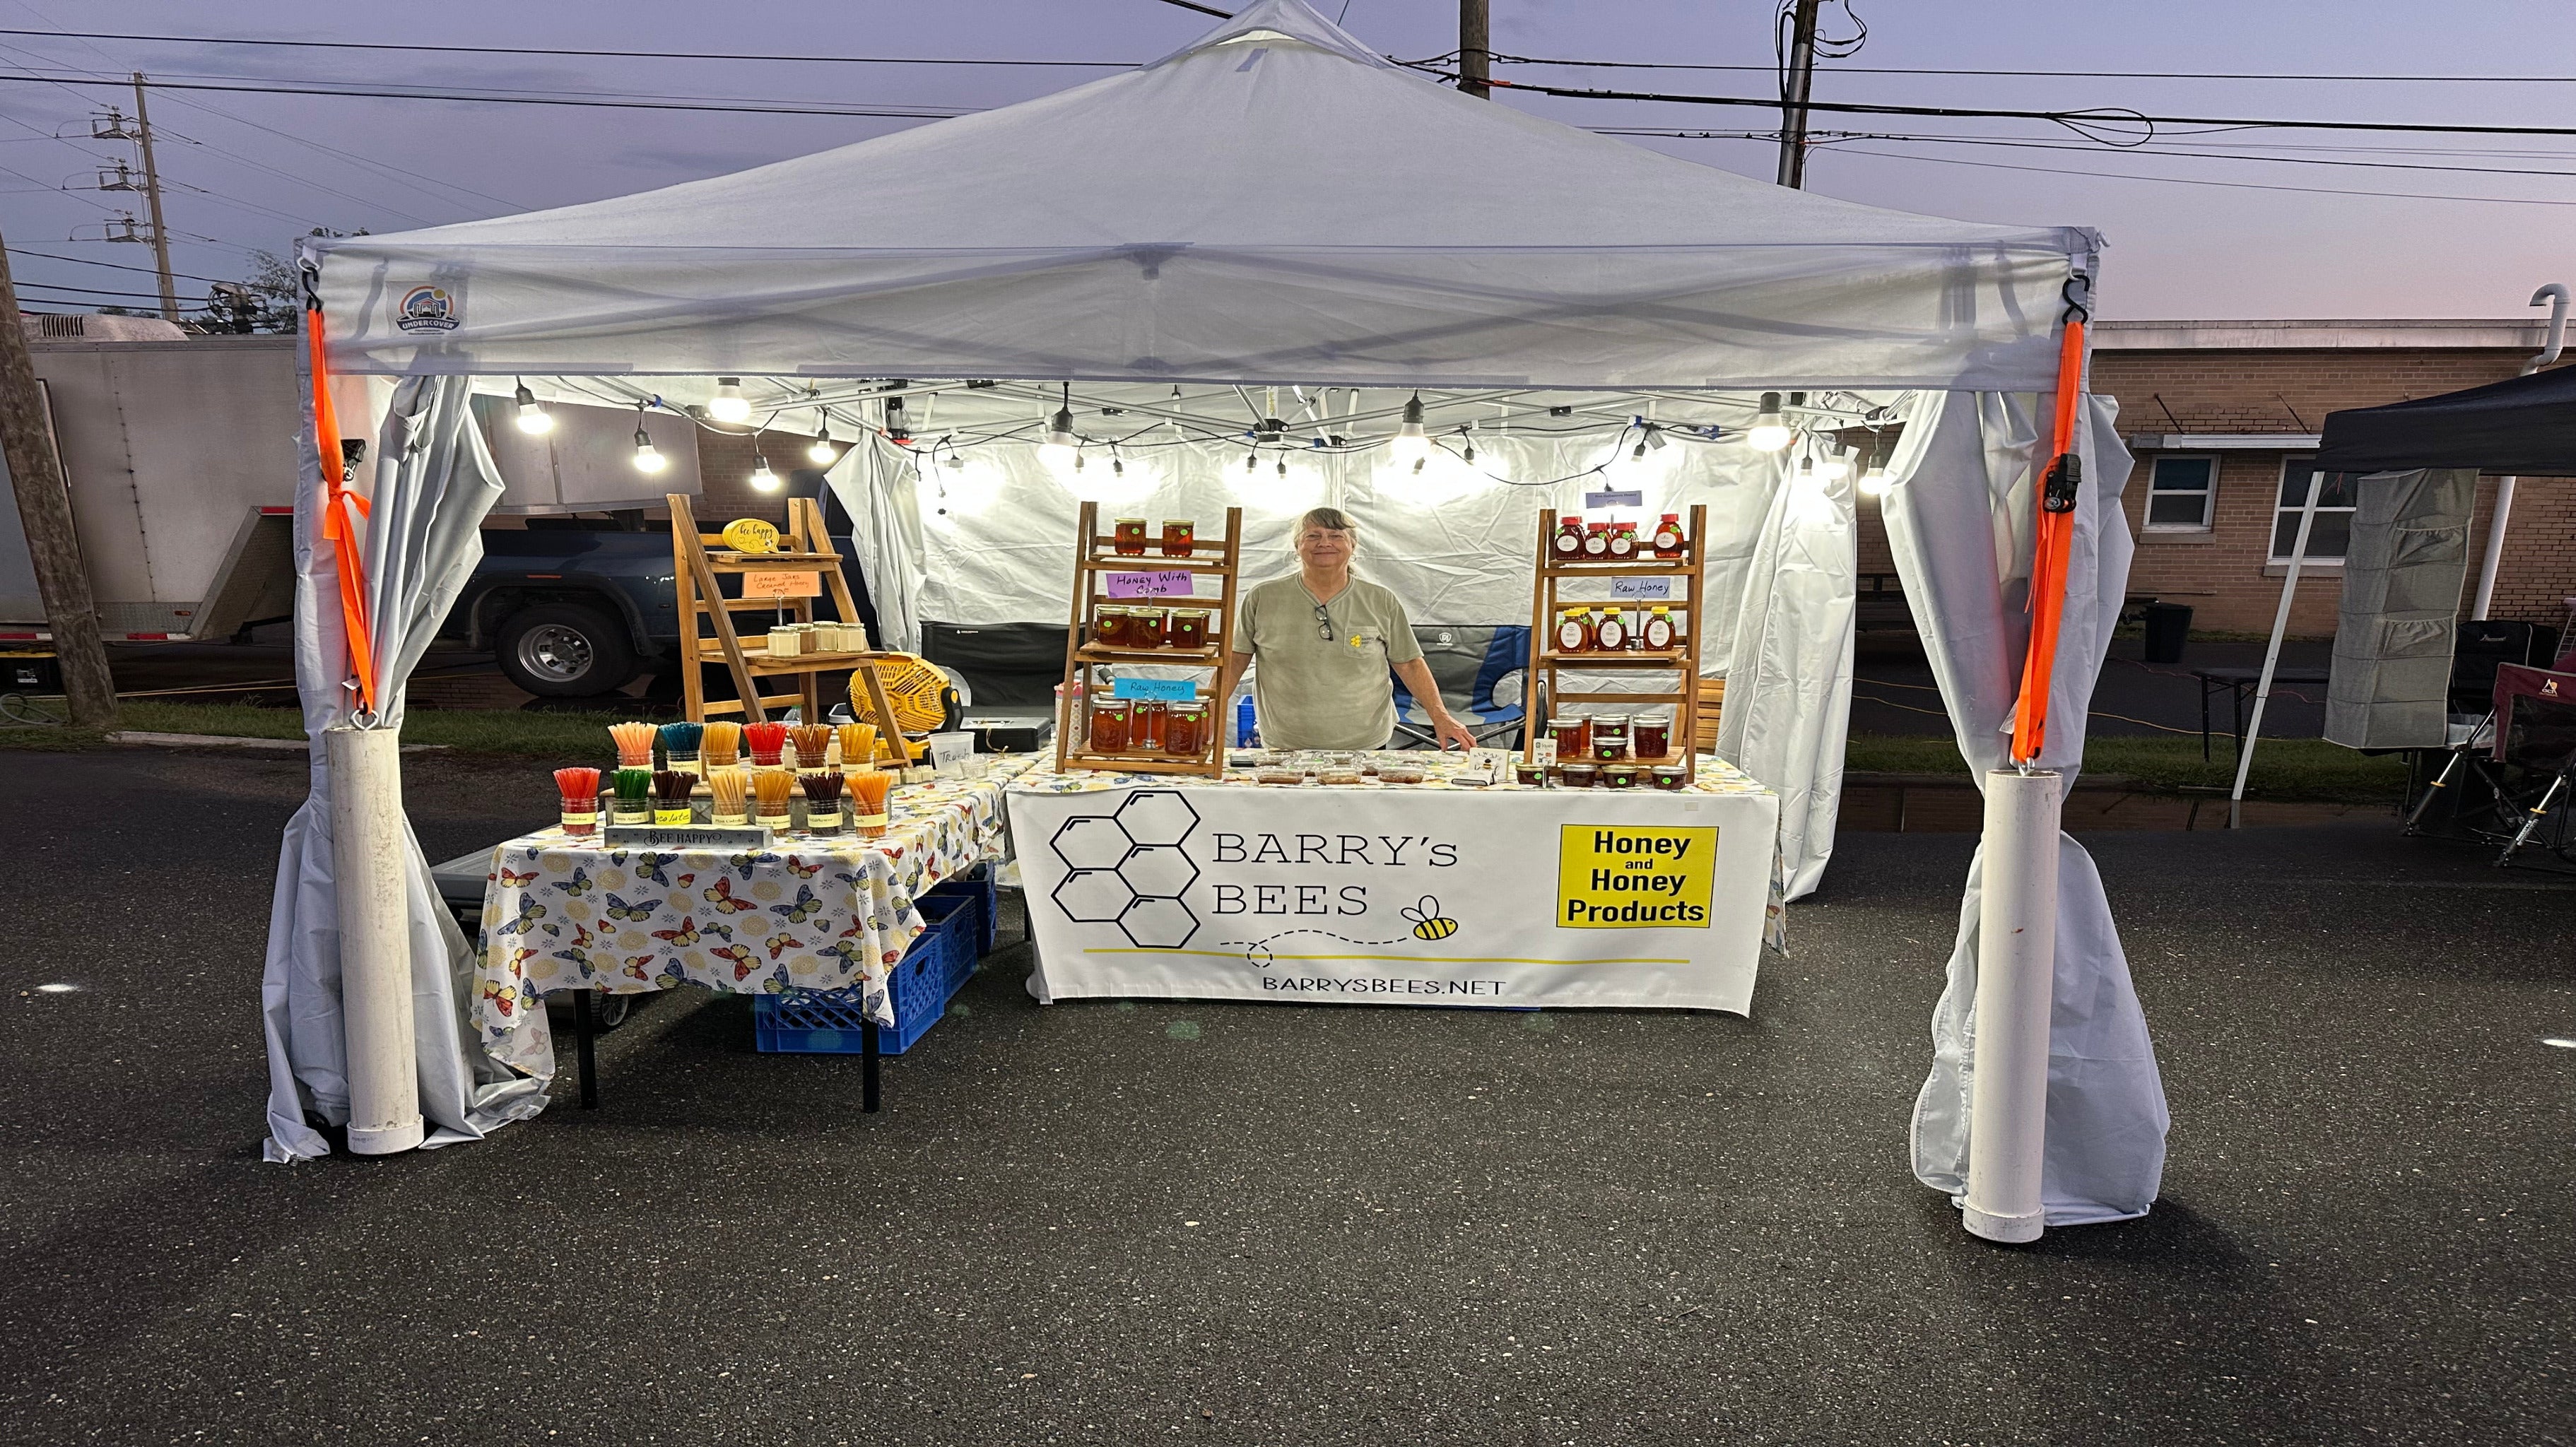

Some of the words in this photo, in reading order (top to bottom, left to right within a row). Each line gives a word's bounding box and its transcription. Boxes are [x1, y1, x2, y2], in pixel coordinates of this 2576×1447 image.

[402, 319, 454, 329] UNDERCOVER
[740, 524, 751, 535] bee
[753, 524, 772, 539] happy
[1158, 572, 1187, 582] With
[1615, 581, 1635, 593] Raw
[1640, 581, 1669, 596] Honey
[1131, 682, 1149, 692] Raw
[1153, 682, 1185, 696] Honey
[676, 832, 722, 844] HAPPY
[1594, 831, 1692, 861] Honey
[1625, 858, 1654, 870] and
[1591, 868, 1687, 897] Honey
[1212, 885, 1368, 916] BEES
[1567, 899, 1705, 922] Products
[1262, 976, 1507, 996] BARRYSBEES.NET
